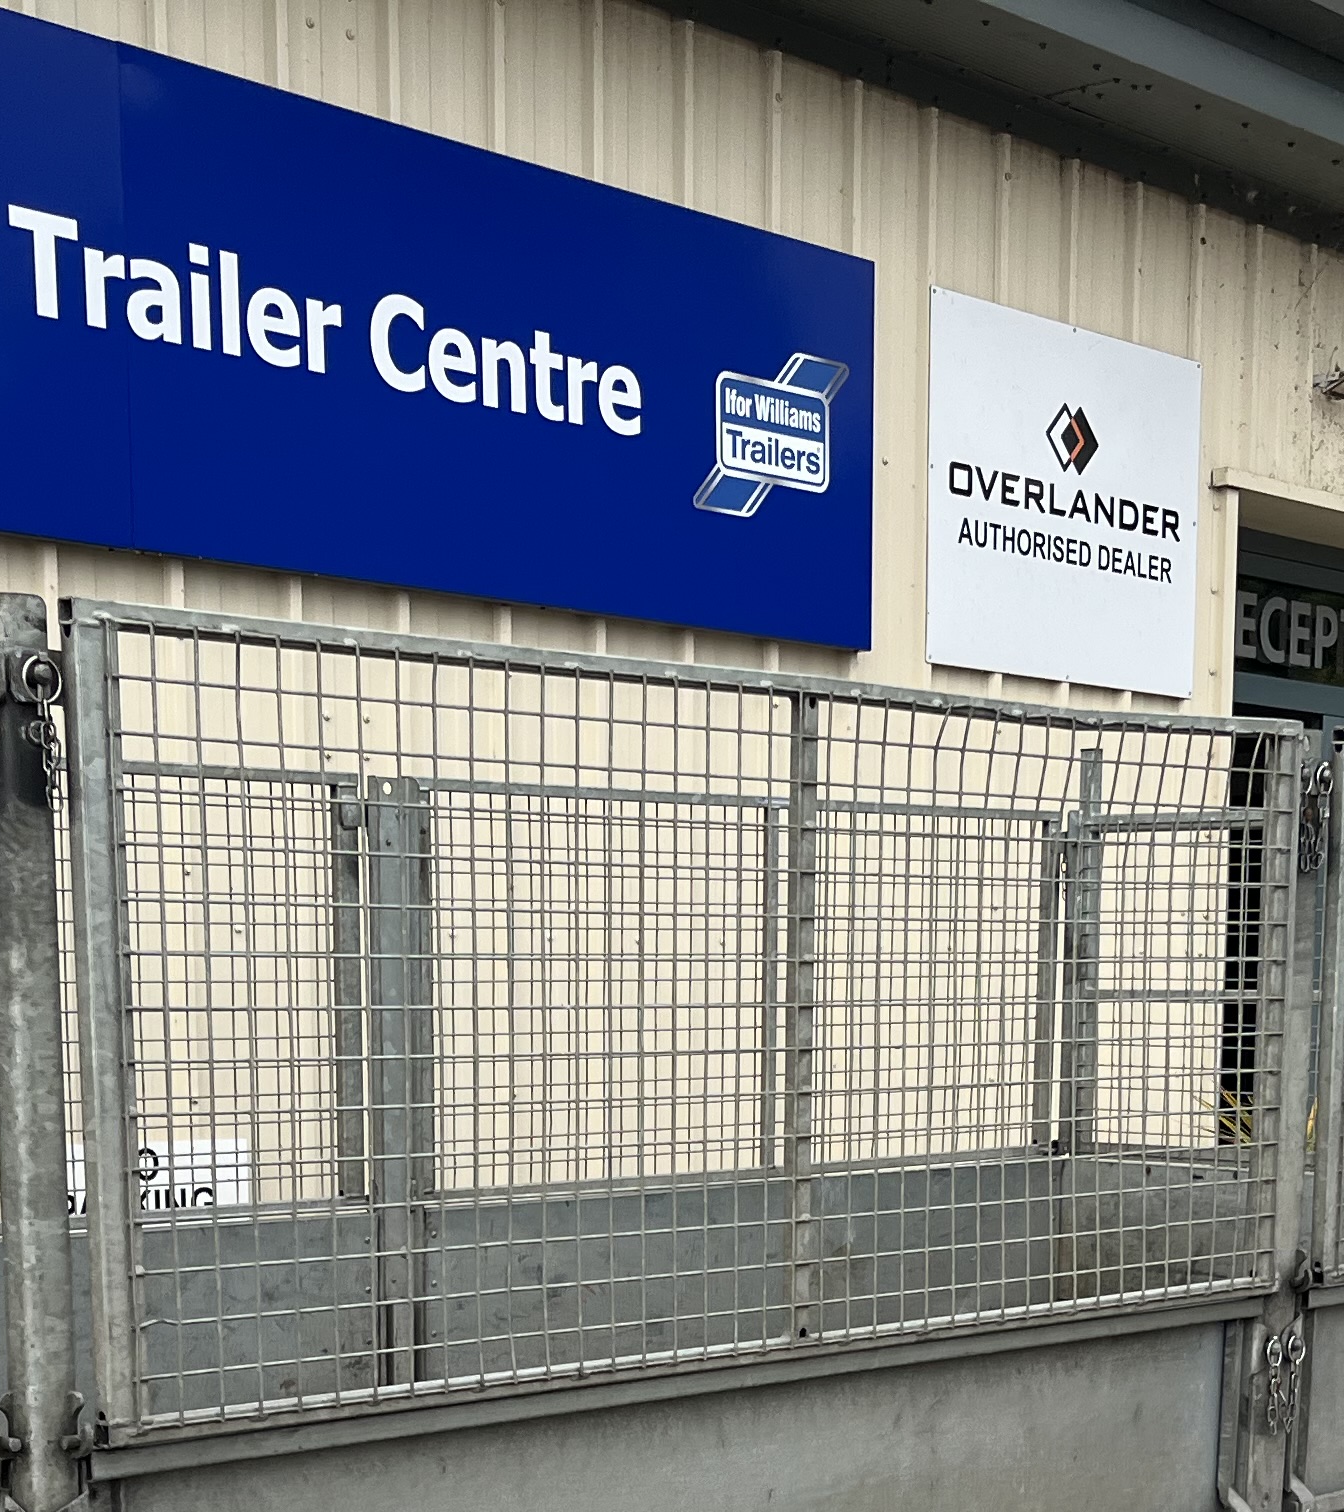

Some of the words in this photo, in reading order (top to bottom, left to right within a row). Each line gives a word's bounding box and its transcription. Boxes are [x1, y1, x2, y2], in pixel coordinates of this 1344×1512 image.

[8, 204, 342, 374] Trailer
[370, 293, 643, 436] Centre
[724, 387, 753, 419] Ifor
[754, 393, 821, 433] Williams
[725, 427, 821, 476] Trailers
[948, 460, 1181, 542] OVERLANDER
[957, 517, 1092, 568] AUTHORISED
[1097, 544, 1173, 584] DEALER
